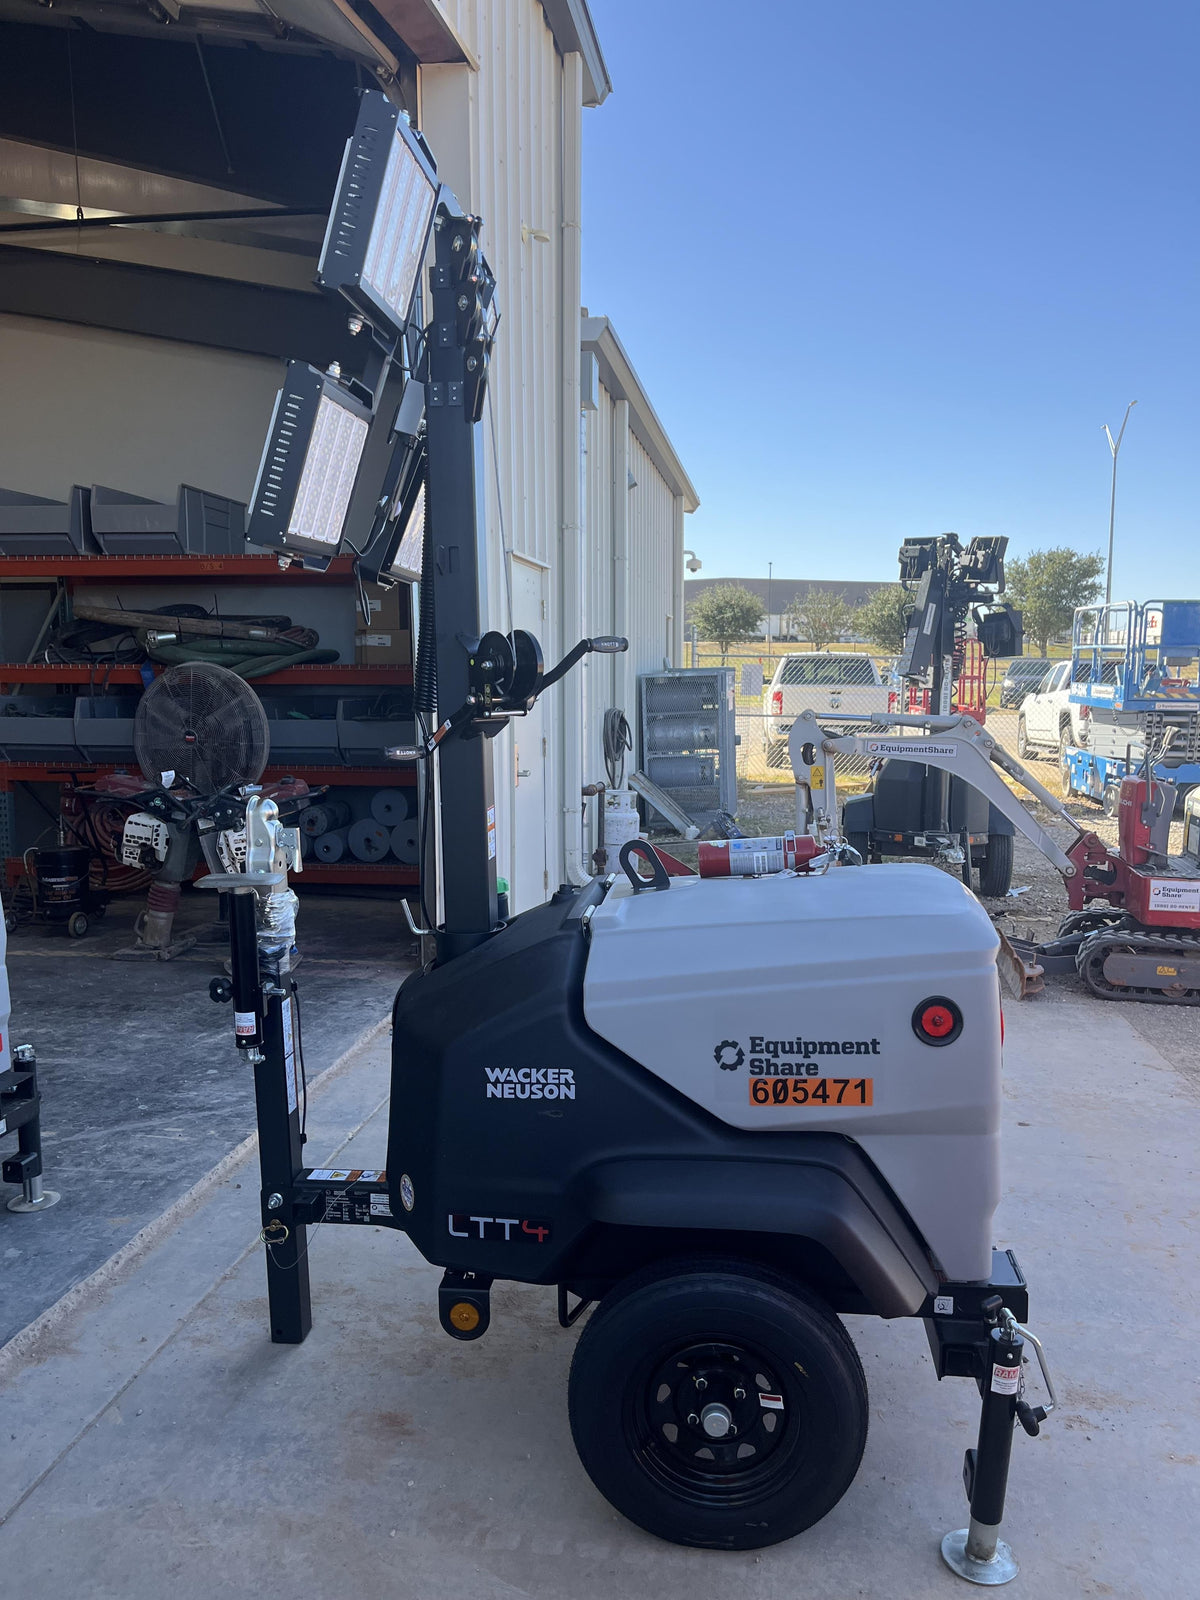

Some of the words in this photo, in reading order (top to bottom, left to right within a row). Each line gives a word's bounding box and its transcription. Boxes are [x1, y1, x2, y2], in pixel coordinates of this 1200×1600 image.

[880, 744, 954, 754] EquipmentShare
[749, 1036, 881, 1059] Equipment
[484, 1067, 576, 1084] WACKER
[749, 1058, 819, 1076] Share
[486, 1083, 576, 1100] NEUSON
[752, 1078, 867, 1104] 605471
[994, 1367, 1018, 1378] RAM
